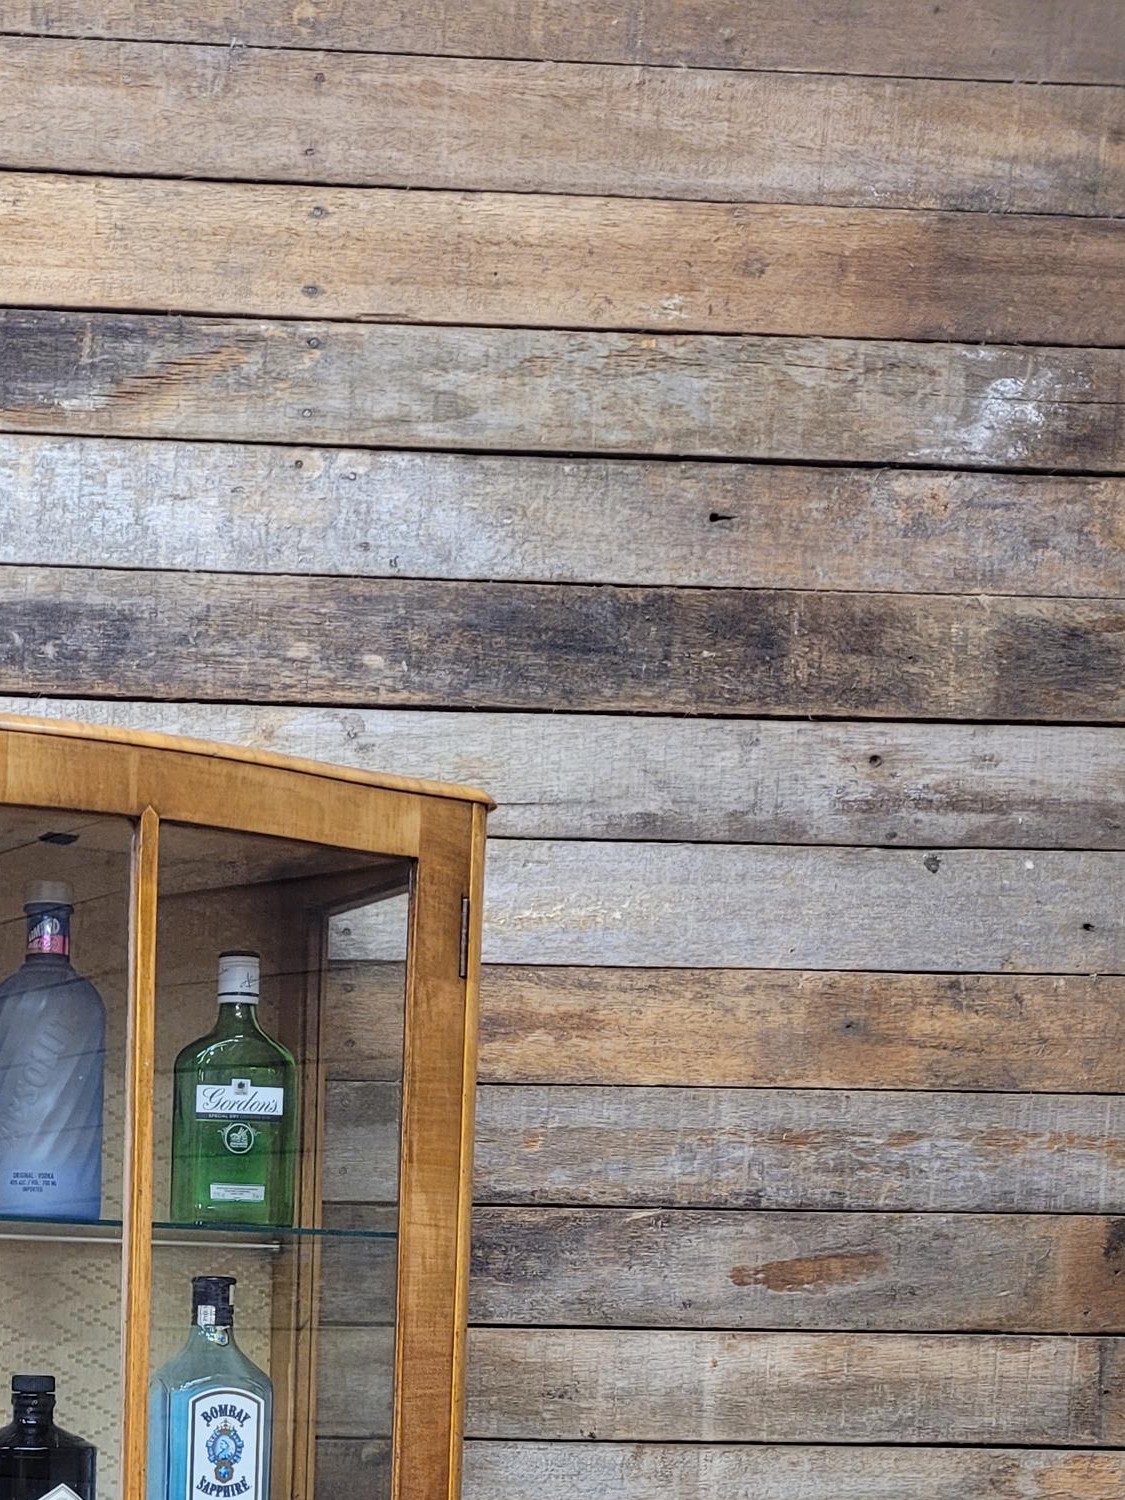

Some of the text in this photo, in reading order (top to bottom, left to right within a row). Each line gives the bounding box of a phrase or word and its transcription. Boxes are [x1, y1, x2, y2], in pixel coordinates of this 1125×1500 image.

[202, 1087, 278, 1113] Gordon's
[200, 1404, 251, 1427] BOMBAY
[196, 1475, 251, 1497] SAPPHIRE
